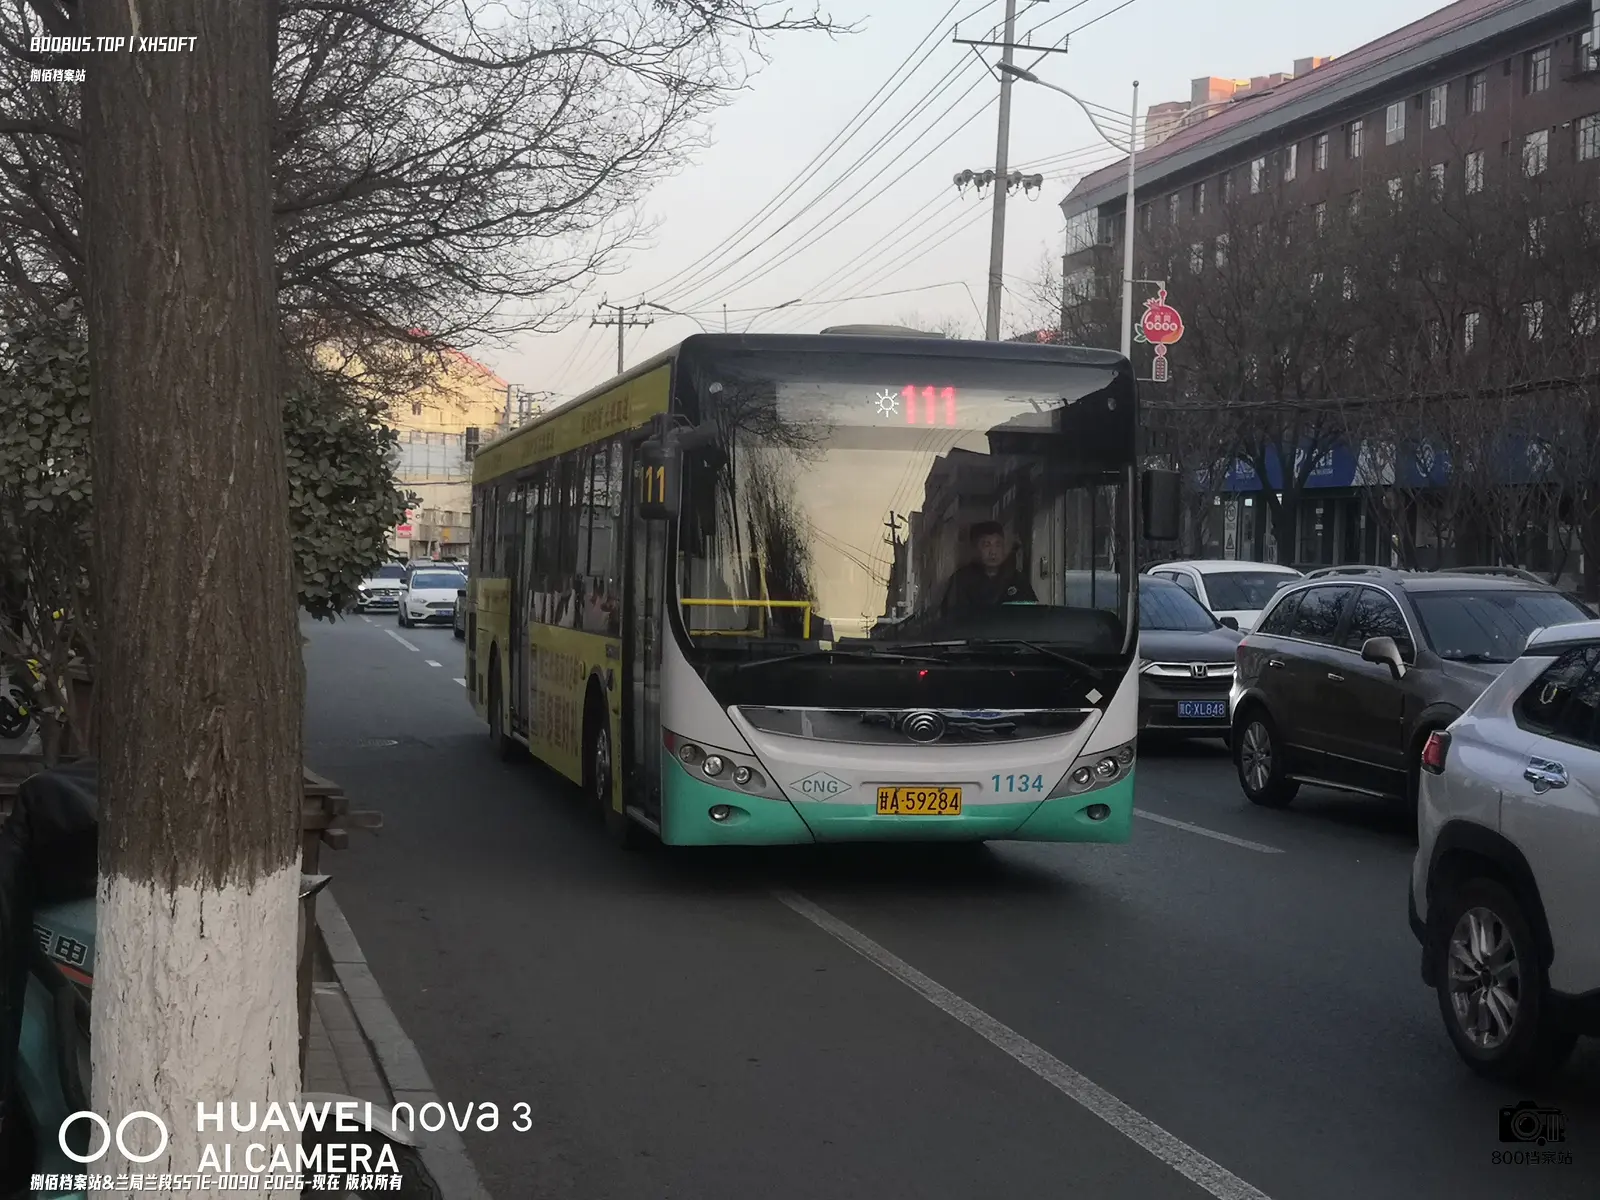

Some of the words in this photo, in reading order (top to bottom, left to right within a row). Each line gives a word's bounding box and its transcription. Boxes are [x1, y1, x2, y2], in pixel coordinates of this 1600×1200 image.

[901, 384, 956, 424] 111
[802, 780, 838, 795] CNG
[991, 774, 1044, 793] 1134
